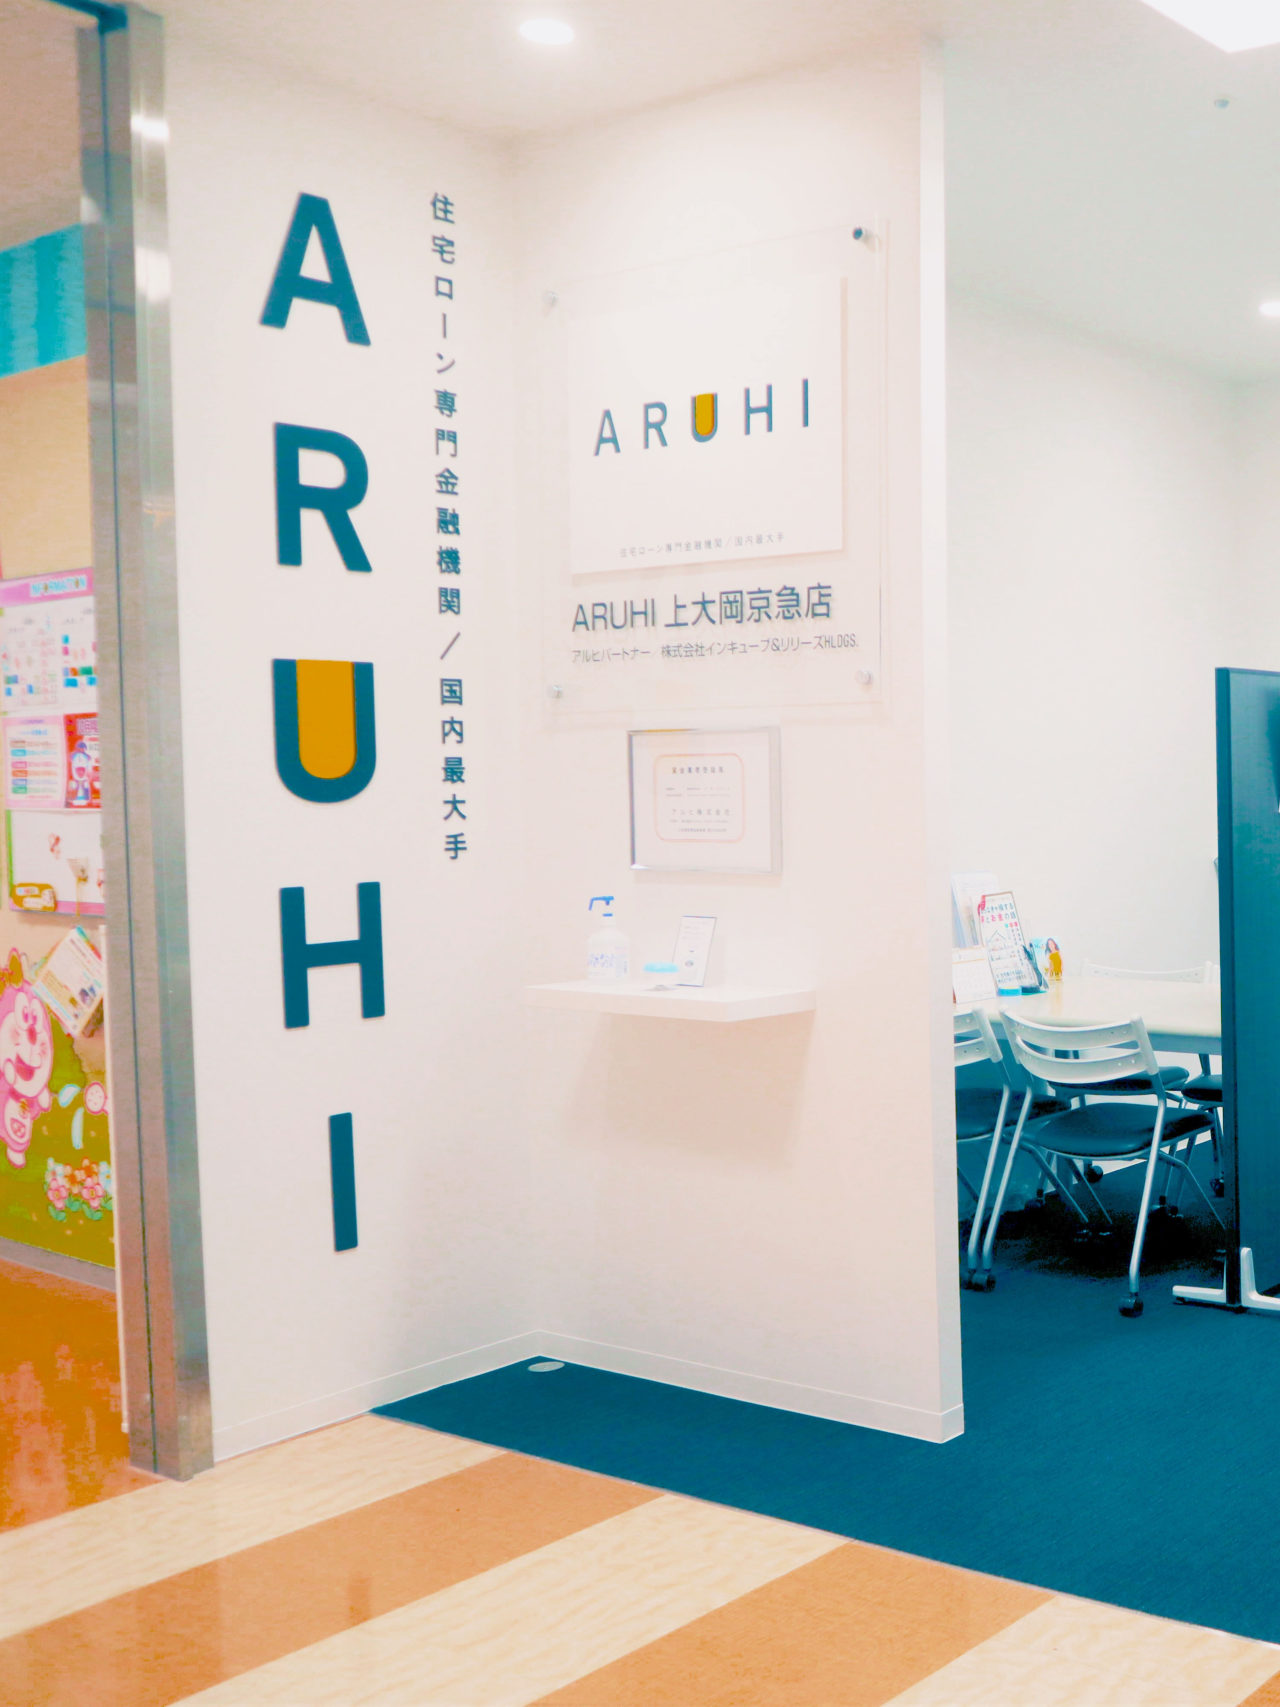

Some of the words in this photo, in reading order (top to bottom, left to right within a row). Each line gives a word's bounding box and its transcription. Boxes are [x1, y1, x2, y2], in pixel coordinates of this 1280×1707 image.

[593, 377, 809, 457] ARUHI
[571, 597, 656, 633] ARUHI
[663, 582, 833, 630] 上大岡京急店
[260, 192, 386, 1252] ARUHI
